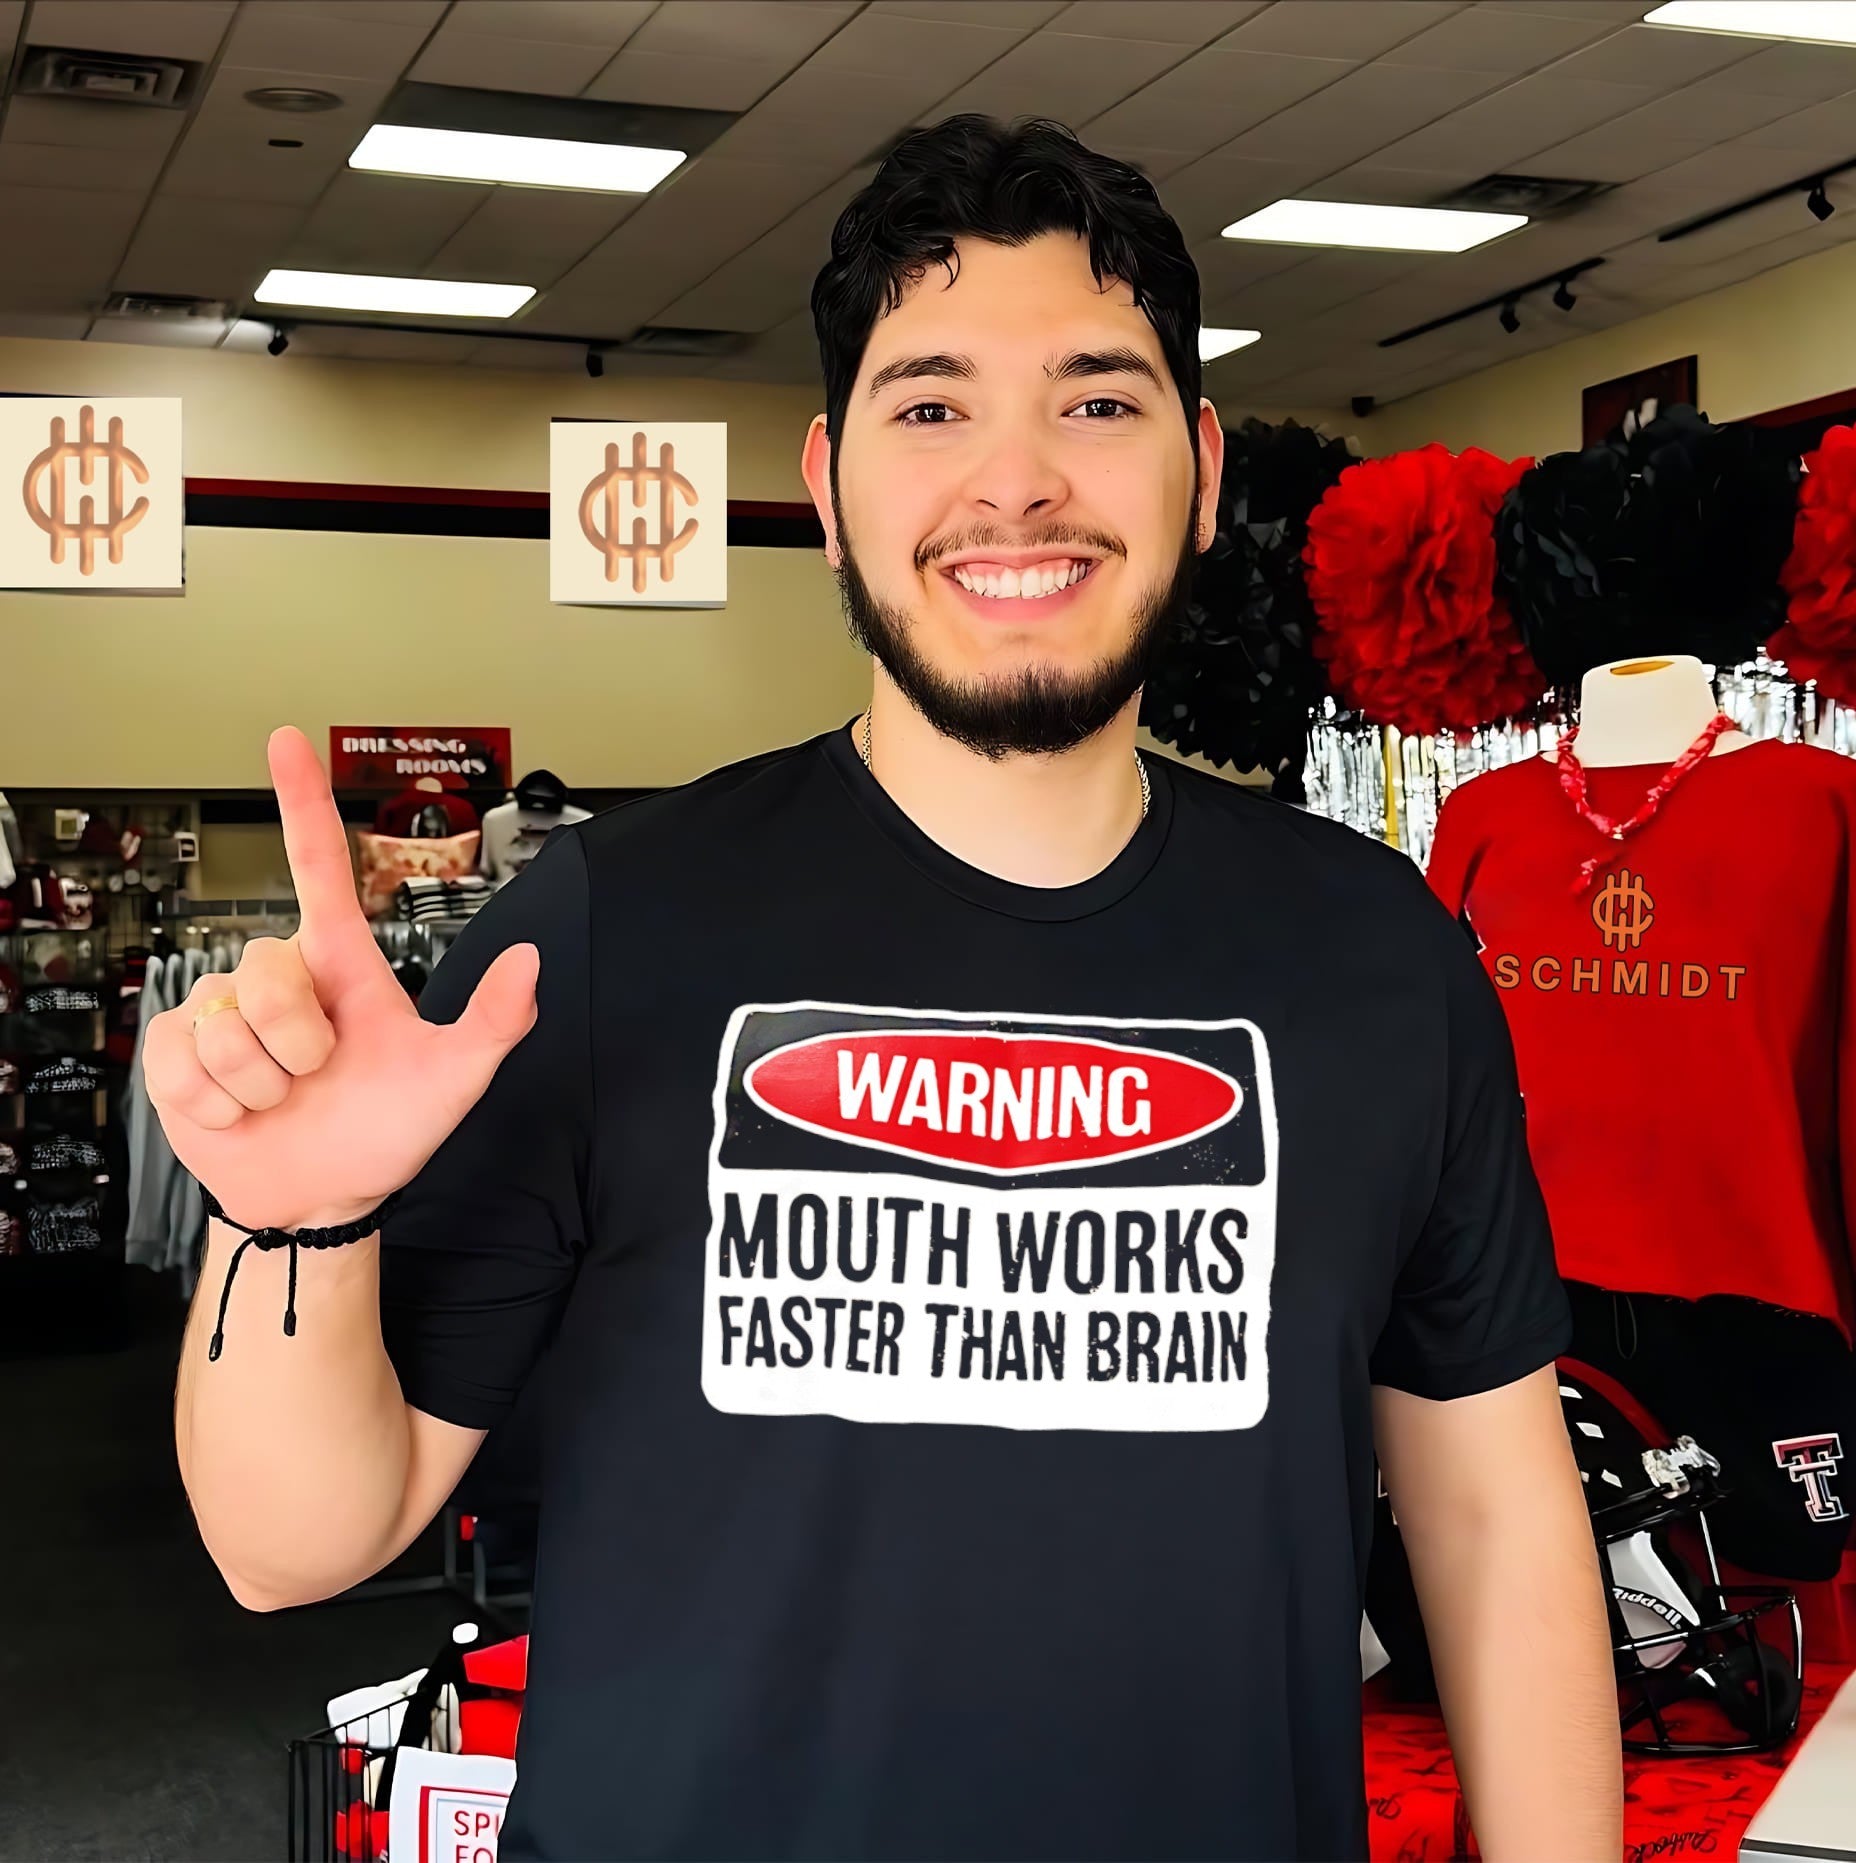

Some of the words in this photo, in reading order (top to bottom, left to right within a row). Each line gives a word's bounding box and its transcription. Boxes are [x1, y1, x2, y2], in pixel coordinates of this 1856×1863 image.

[342, 737, 467, 753] DRESSING
[396, 758, 487, 775] ROOMS
[1494, 954, 1747, 1000] SCHMIDT
[837, 1049, 1151, 1142] WARNING
[719, 1192, 971, 1289] MOUTH
[997, 1208, 1248, 1295] WORKS
[719, 1296, 905, 1376] FASTER
[925, 1303, 1066, 1381] THAN
[1087, 1311, 1248, 1383] BRAIN
